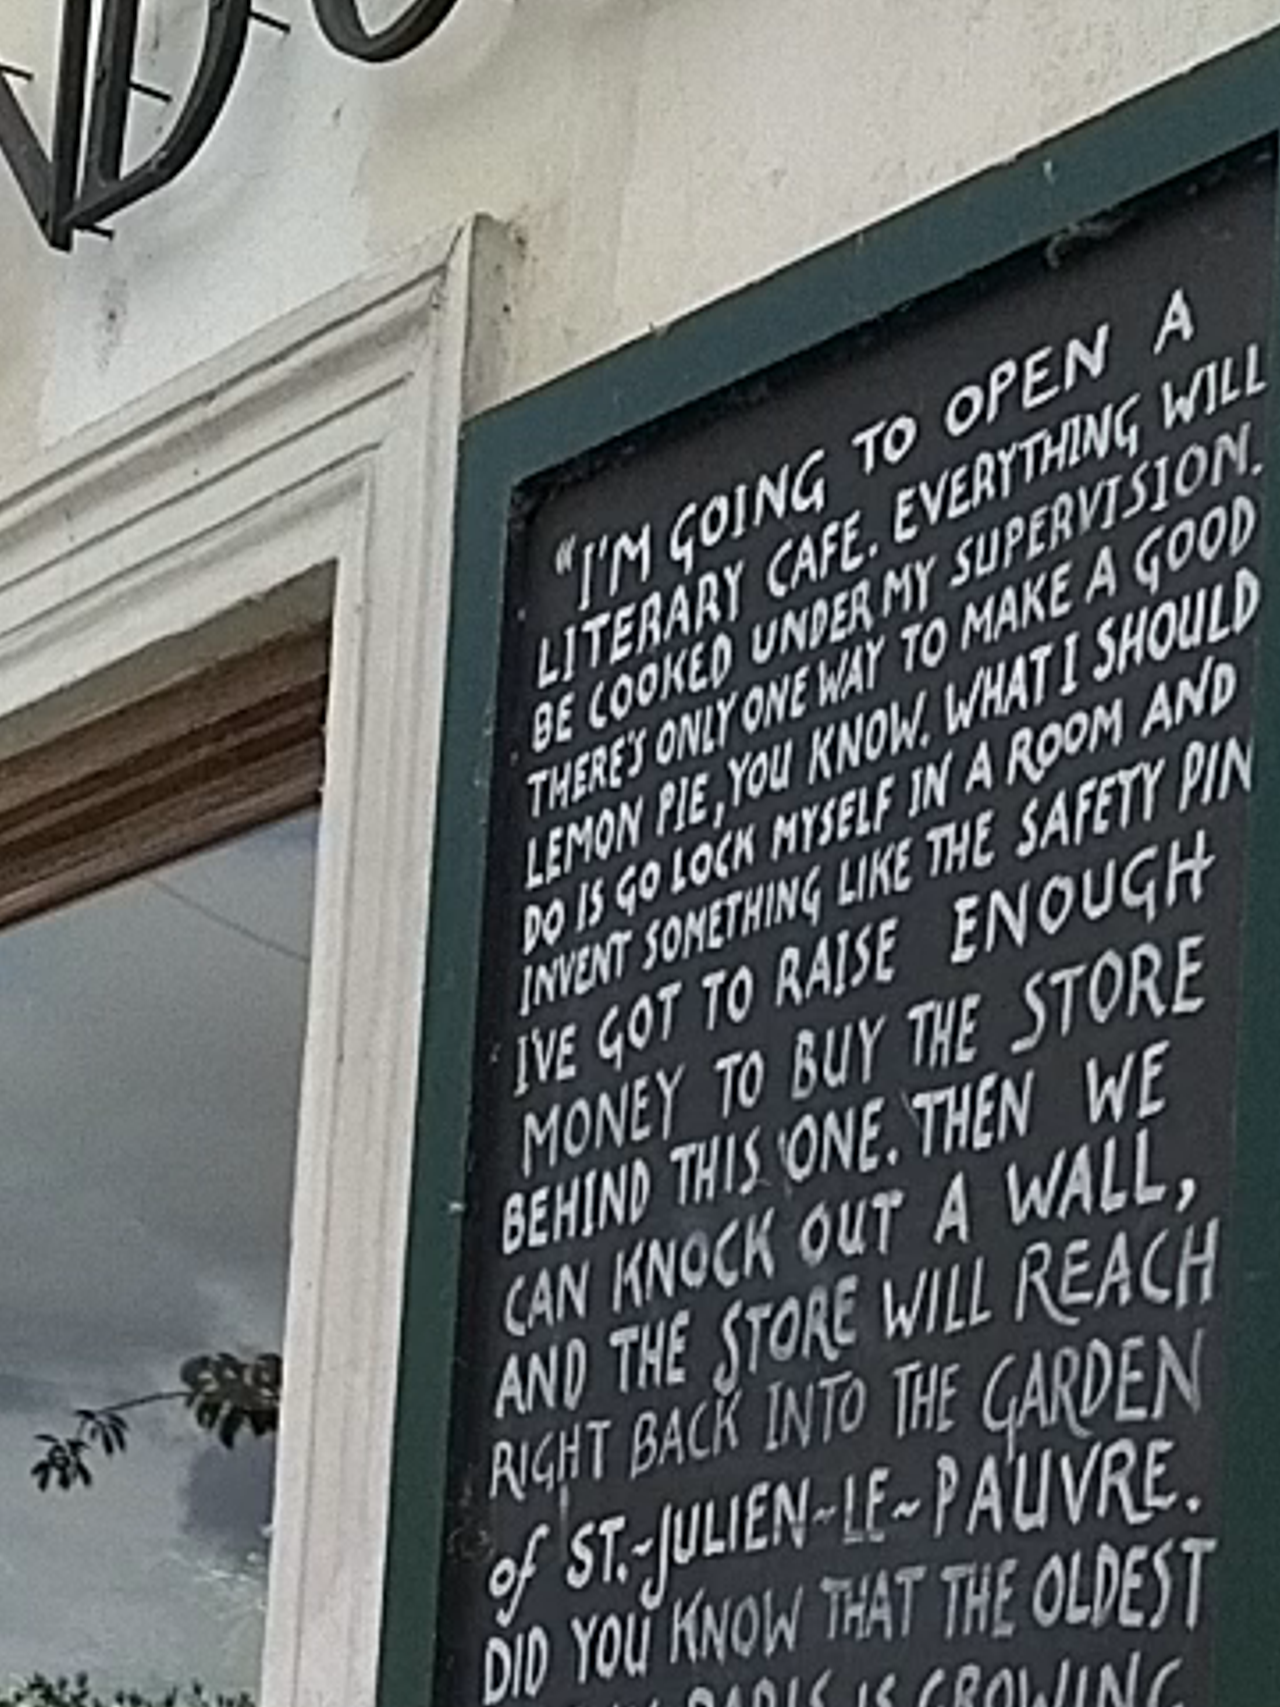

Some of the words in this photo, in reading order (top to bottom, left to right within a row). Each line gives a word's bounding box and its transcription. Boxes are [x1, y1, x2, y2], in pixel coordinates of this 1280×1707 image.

[537, 563, 743, 688] LITERARY
[765, 512, 879, 598] CAFE.
[893, 398, 1139, 541] EVERYTHING
[1161, 345, 1268, 429] WILL
[670, 451, 826, 563] GOING
[852, 414, 918, 476] TO
[945, 324, 1111, 437] OPEN
[1153, 290, 1195, 354] A
[528, 732, 645, 816] THERE'S
[656, 693, 736, 765] ONLY
[741, 671, 808, 735] ONE
[817, 638, 886, 701] WAY
[899, 615, 947, 673] TO
[962, 572, 1072, 654] MAKE
[1084, 548, 1117, 602] A
[1134, 495, 1258, 590] GOOD
[532, 695, 574, 752] BE
[588, 637, 732, 724] COOKED
[751, 584, 875, 663] UNDER
[881, 562, 936, 620] MY
[950, 423, 1265, 585] SUPERVISION.
[525, 901, 564, 955] DO
[576, 885, 604, 934] IS
[615, 857, 661, 915] GO
[672, 824, 754, 895] LOCK
[772, 776, 895, 854] MYSELF
[909, 757, 950, 818] IN
[964, 741, 993, 791] A
[1008, 699, 1122, 785] ROOM
[1142, 657, 1237, 737] AND
[526, 802, 642, 890] LEMON
[656, 771, 723, 835] PIE,
[729, 745, 792, 810] YOU
[808, 695, 929, 784] KNOW.
[945, 648, 1050, 734] WHAT
[1061, 646, 1078, 695] I
[1092, 566, 1262, 681] SHOULD
[515, 1022, 577, 1095] I'VE
[599, 984, 681, 1062] GOT
[702, 966, 754, 1030] TO
[776, 916, 900, 1007] RAISE
[950, 838, 1214, 963] ENOUGH
[520, 931, 632, 1016] INVENT
[641, 874, 821, 970] SOMETHING
[837, 841, 914, 909] LIKE
[926, 815, 995, 877] THE
[1017, 765, 1161, 855] SAFETY
[1179, 735, 1254, 812] PIN
[502, 1157, 652, 1254] BEHIND
[670, 1126, 763, 1207] THIS
[781, 1097, 899, 1180] ONE.
[912, 1070, 1033, 1157] THEN
[1086, 1039, 1171, 1124] WE
[522, 1065, 685, 1177] MONEY
[715, 1053, 764, 1118] TO
[794, 1015, 887, 1097] BUY
[908, 994, 981, 1067] THE
[1010, 935, 1206, 1053] STORE
[494, 1340, 586, 1418] AND
[609, 1311, 690, 1394] THE
[714, 1275, 861, 1396] STORE
[882, 1257, 992, 1340] WILL
[1015, 1218, 1221, 1326] REACH
[504, 1259, 590, 1336] CAN
[612, 1207, 776, 1313] KNOCK
[799, 1190, 904, 1266] OUT
[934, 1172, 969, 1244] A
[1007, 1129, 1196, 1226] WALL,
[490, 1418, 612, 1499] RIGHT
[630, 1389, 743, 1480] BACK
[764, 1371, 867, 1453] INTO
[892, 1359, 959, 1439] THE
[981, 1329, 1206, 1461] GARDEN
[483, 1627, 547, 1705] DID
[571, 1614, 651, 1682] YOU
[671, 1585, 803, 1666] KNOW
[820, 1565, 925, 1642] THAT
[941, 1558, 1016, 1640] THE
[1033, 1537, 1217, 1629] OLDEST
